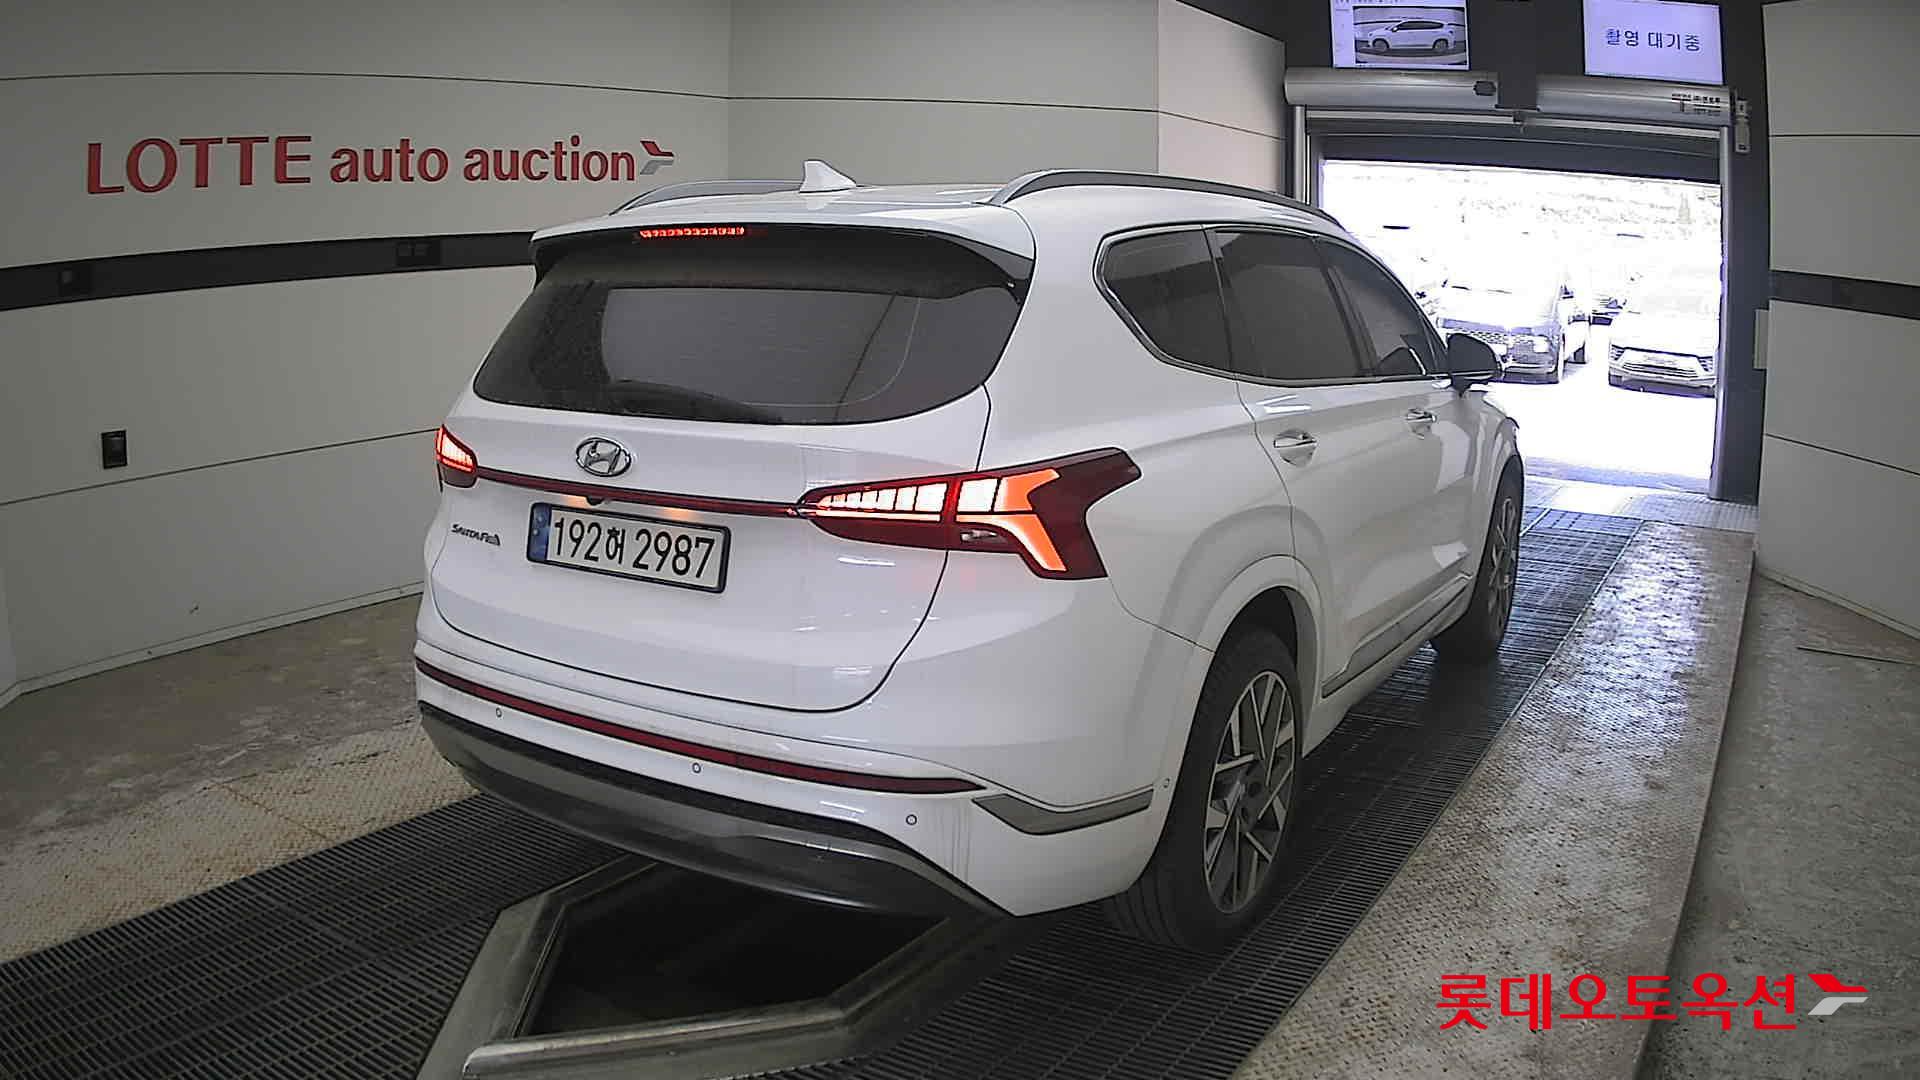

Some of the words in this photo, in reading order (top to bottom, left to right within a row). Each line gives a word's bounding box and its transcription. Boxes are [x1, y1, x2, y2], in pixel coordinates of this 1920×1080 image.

[87, 135, 312, 194] LOTTE
[329, 138, 449, 184] auto
[463, 135, 636, 182] auction
[632, 527, 716, 579] 2987
